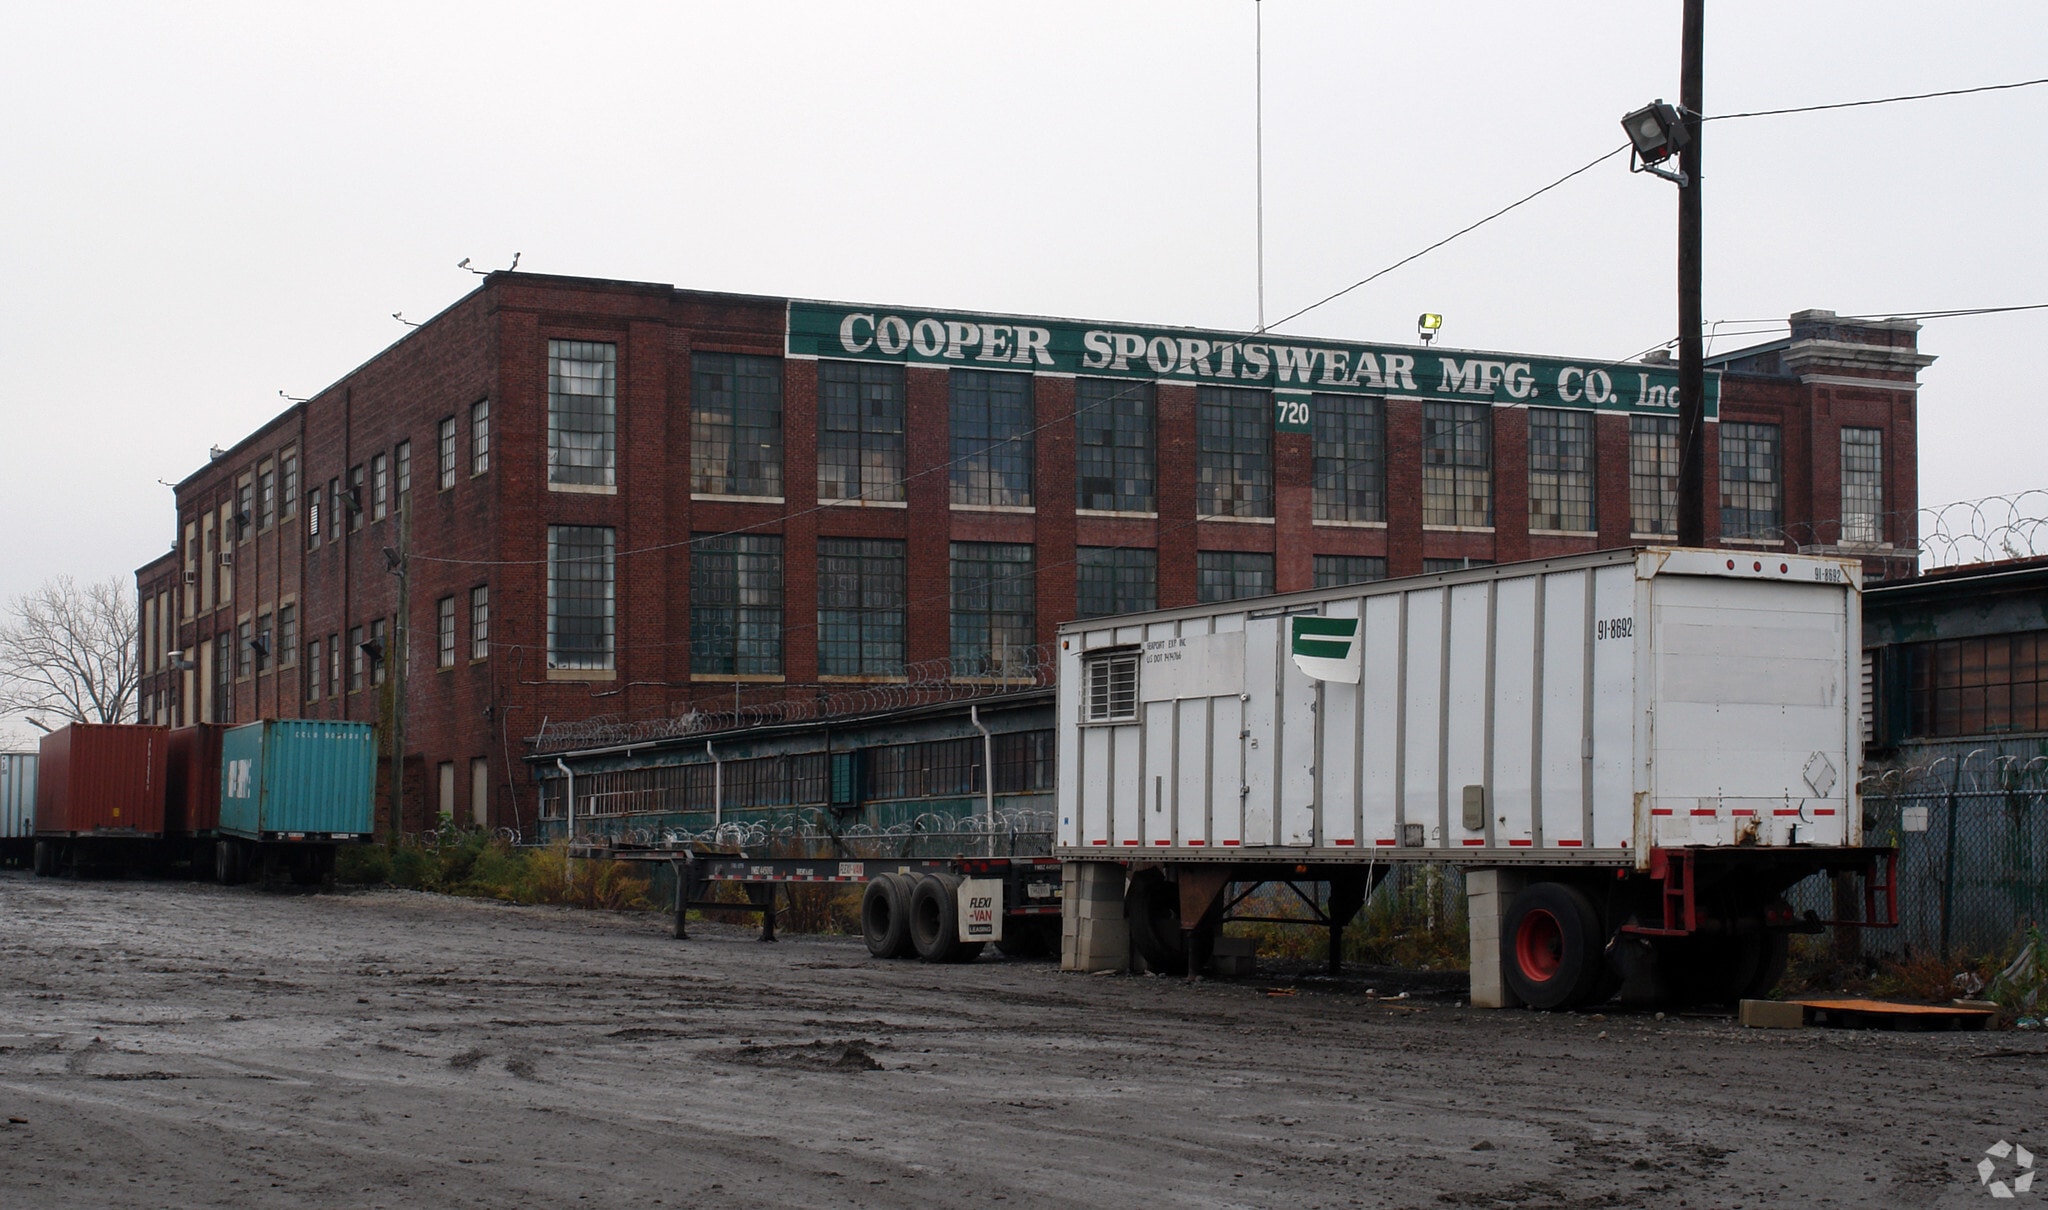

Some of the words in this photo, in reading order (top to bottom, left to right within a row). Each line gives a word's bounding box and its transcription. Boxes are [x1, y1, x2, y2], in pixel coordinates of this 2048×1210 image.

[839, 313, 1055, 365] COOPER
[1083, 330, 1417, 390] SPORTSWEAR
[1437, 357, 1539, 398] MFG.
[1558, 366, 1617, 404] CO.
[1277, 401, 1309, 424] 720
[1815, 567, 1841, 582] 91-8692
[1598, 617, 1632, 640] 91-8692
[969, 897, 992, 909] FLEXI
